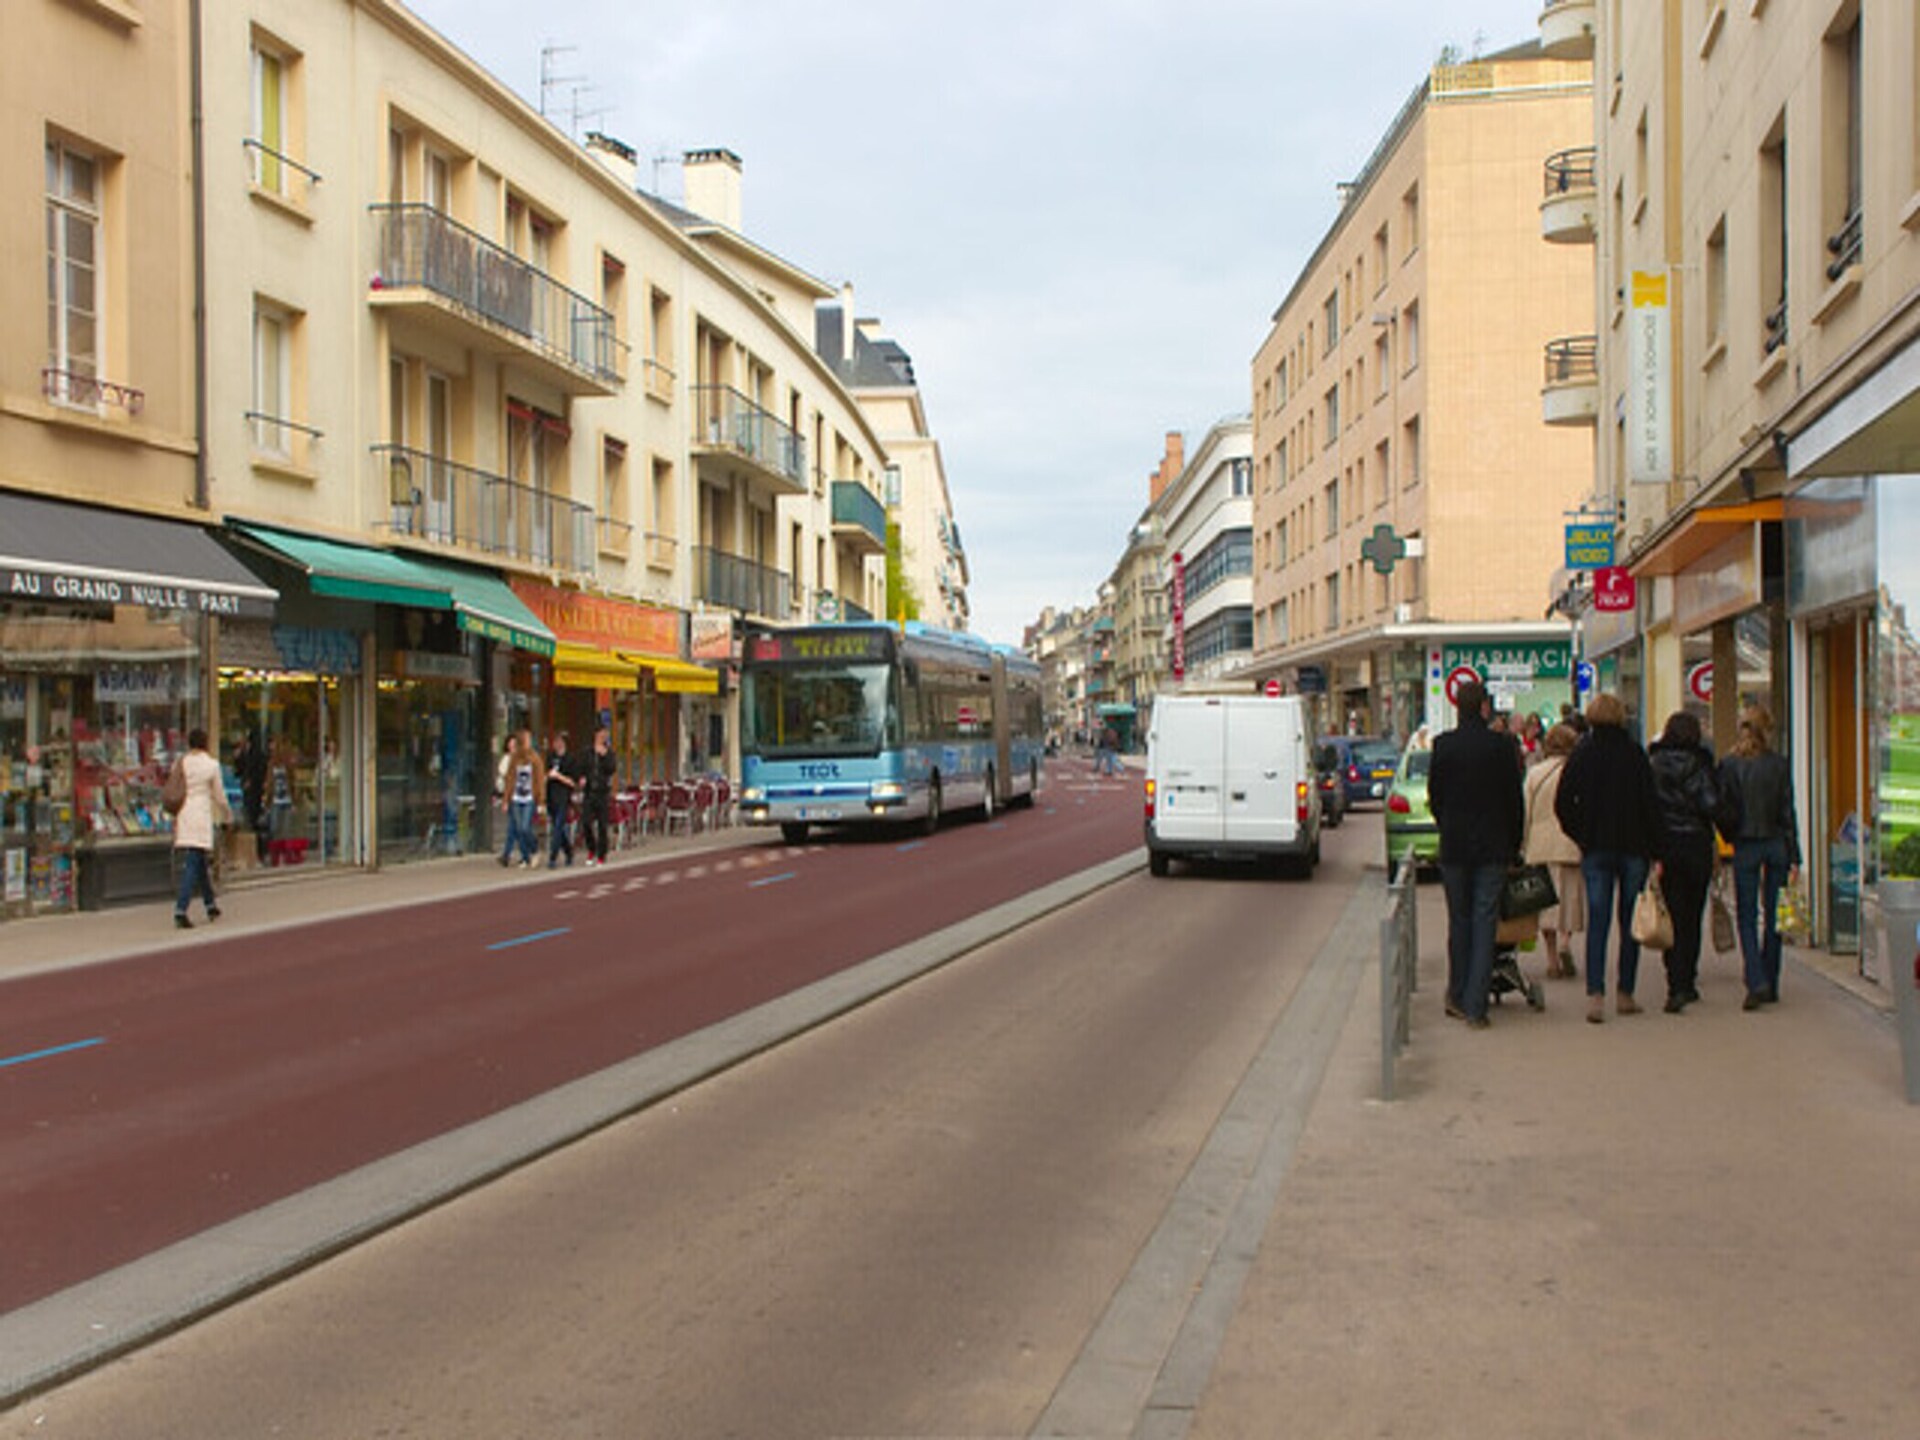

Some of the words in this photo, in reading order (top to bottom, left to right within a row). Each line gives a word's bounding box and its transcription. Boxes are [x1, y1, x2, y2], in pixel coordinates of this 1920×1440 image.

[11, 571, 41, 595] AU
[52, 575, 122, 602] GRAND
[131, 585, 188, 608] NULLE
[200, 592, 240, 614] PART
[1444, 649, 1570, 669] PHARMACI
